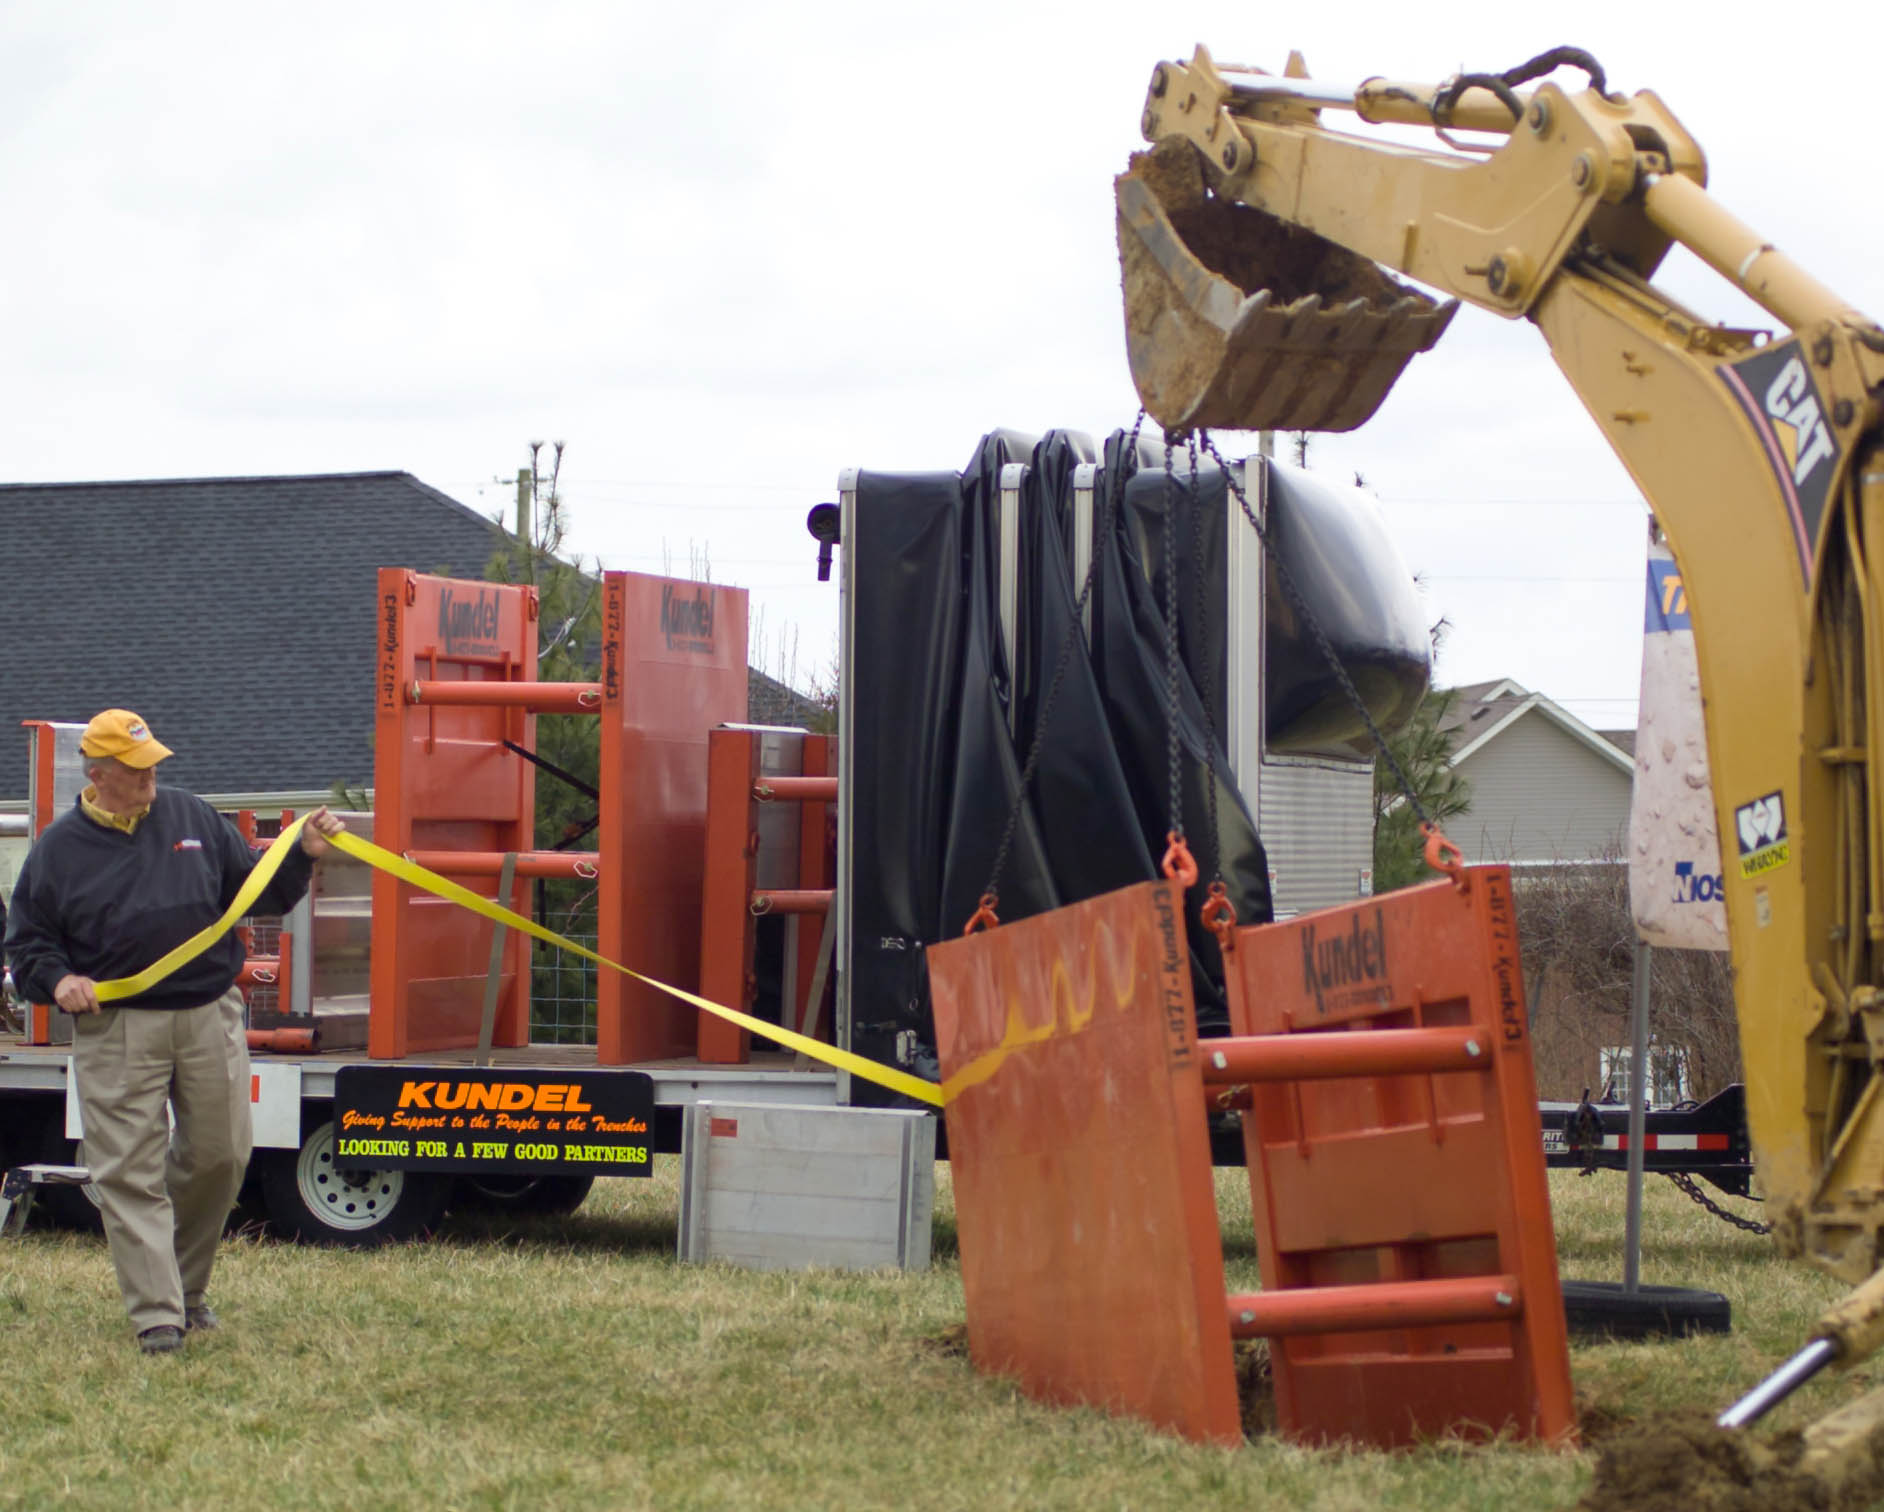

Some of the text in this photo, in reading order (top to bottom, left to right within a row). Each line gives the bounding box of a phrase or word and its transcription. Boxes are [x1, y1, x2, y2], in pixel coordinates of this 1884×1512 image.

[1766, 357, 1835, 486] CAT
[438, 586, 500, 656] Kundel
[661, 584, 715, 651] Kundel
[1302, 906, 1387, 1014] Kundel
[342, 1110, 648, 1133] Giving Support to the People in the Trenches
[398, 1081, 592, 1112] KUNDEL
[339, 1139, 648, 1164] LOOKING FOR A FEW GOOD PARTNERS
